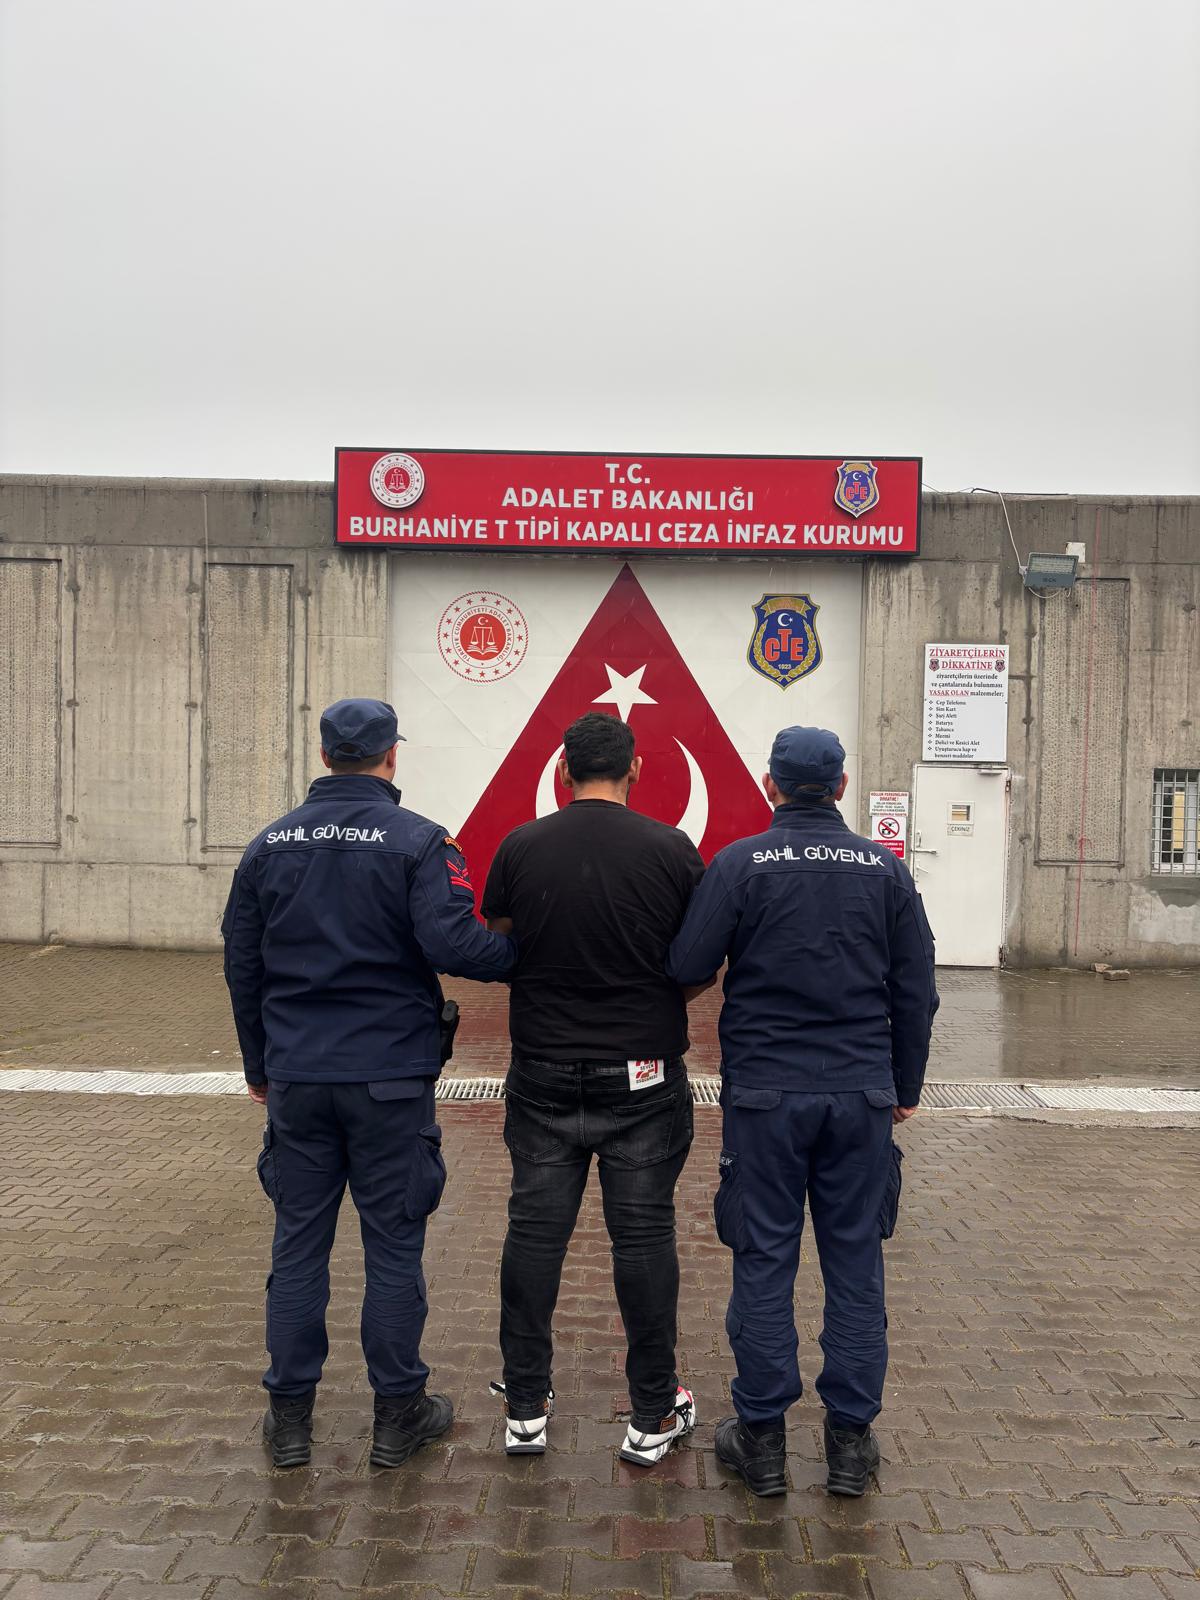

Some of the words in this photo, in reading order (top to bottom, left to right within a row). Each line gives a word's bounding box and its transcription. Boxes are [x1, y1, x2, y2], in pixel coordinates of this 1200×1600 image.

[605, 463, 650, 484] T.C.
[502, 487, 604, 509] ADALET
[612, 486, 753, 511] BAKANLIĞI
[846, 482, 867, 500] CTE
[350, 514, 488, 539] BURHANİYE
[495, 520, 509, 540] T
[515, 516, 559, 541] TİPİ
[567, 521, 650, 542] KAPALI
[658, 522, 720, 543] CEZA
[727, 519, 796, 544] İNFAZ
[803, 524, 904, 546] KURUMU
[454, 607, 488, 636] CUMHURİYETİ
[488, 608, 509, 627] ADALET
[764, 629, 804, 662] CTE
[929, 647, 1006, 659] ZİYARETÇİLERİN
[941, 659, 993, 670] DİKKATİNE
[936, 673, 973, 681] ziyaretçilerin
[266, 825, 310, 844] SAHİL
[312, 824, 388, 843] GÜVENLİK
[752, 845, 801, 864] SAHİL
[804, 844, 885, 867] GÜVENLİK
